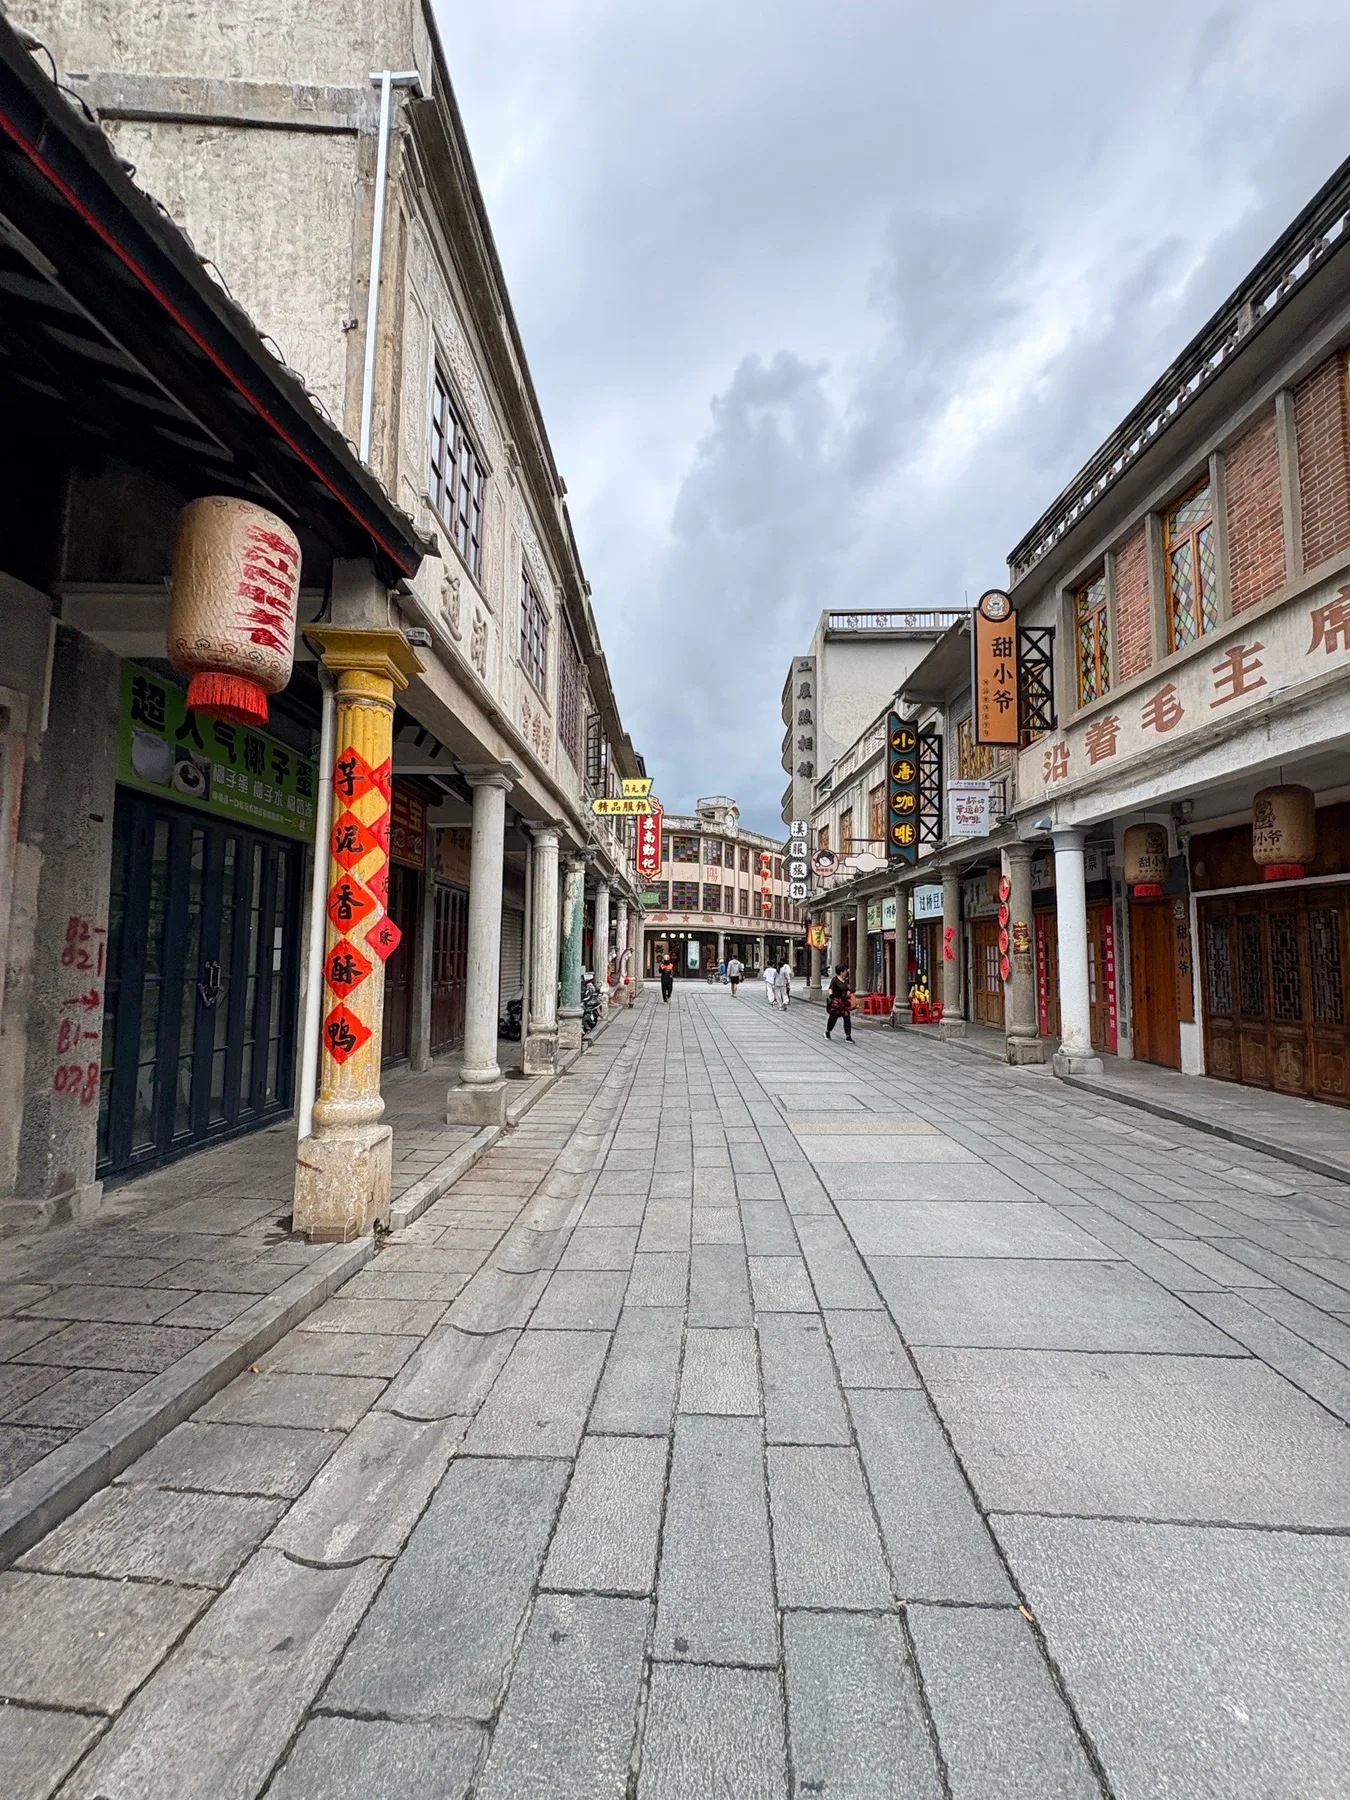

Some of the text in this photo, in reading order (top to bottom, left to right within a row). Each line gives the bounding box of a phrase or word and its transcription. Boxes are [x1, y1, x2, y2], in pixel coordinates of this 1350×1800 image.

[992, 637, 1013, 714] 甜小爷
[892, 733, 914, 843] 小唐咖啡
[327, 757, 365, 1051] 芋泥香酥鸭
